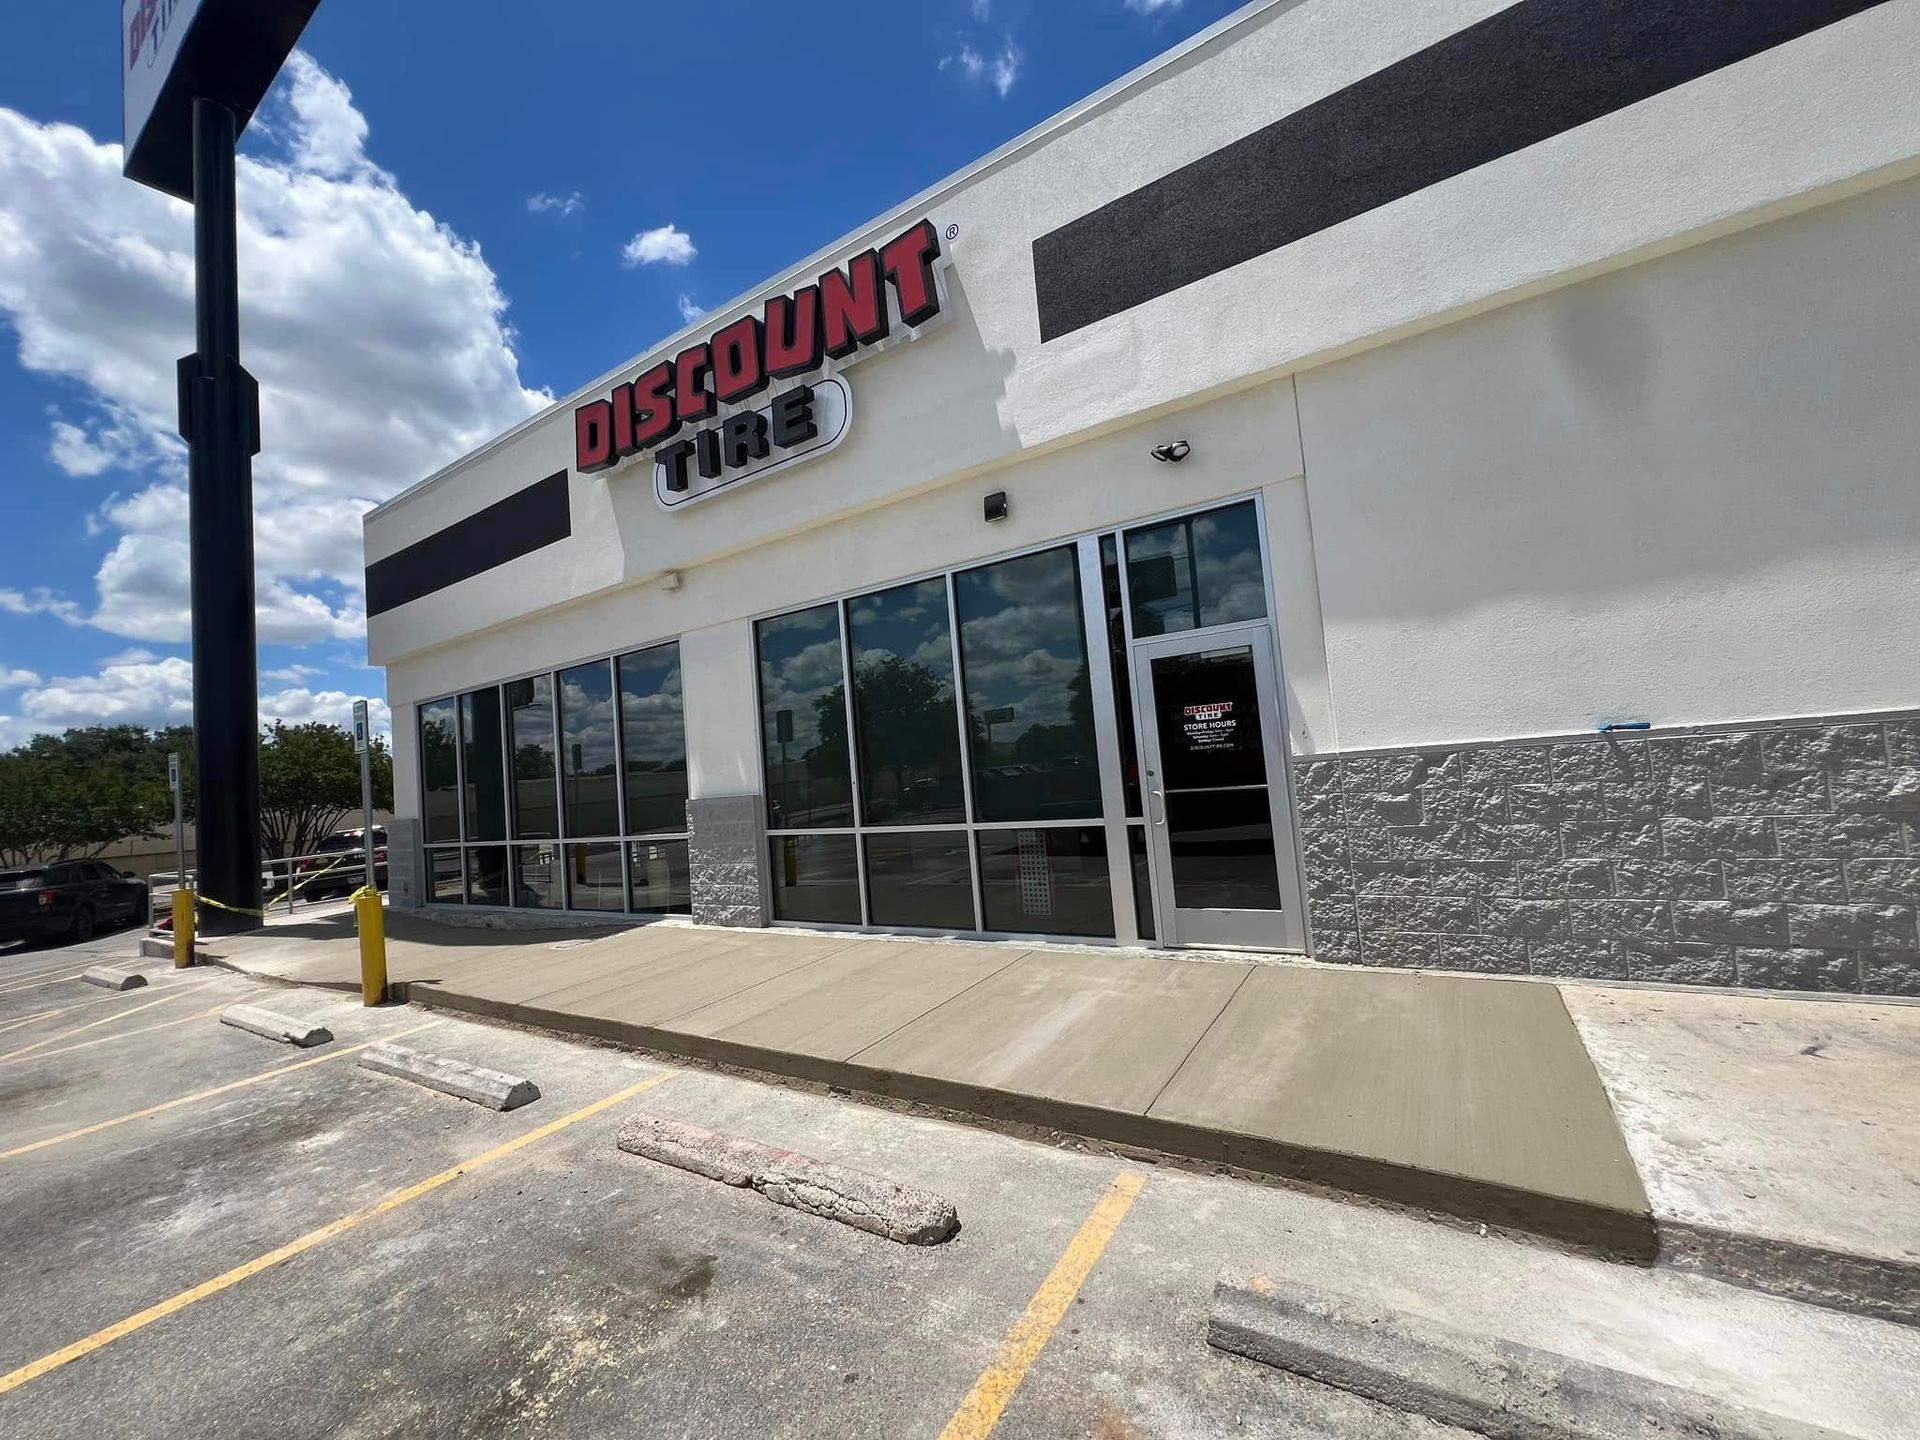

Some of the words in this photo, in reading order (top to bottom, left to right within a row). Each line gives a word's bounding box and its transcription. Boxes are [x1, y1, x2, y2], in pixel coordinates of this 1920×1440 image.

[576, 218, 941, 473] DISCOUNT
[655, 384, 818, 492] TIRE
[1184, 702, 1233, 715] DISCOUNT
[1184, 722, 1208, 731] STORE
[1209, 720, 1237, 729] HOURS
